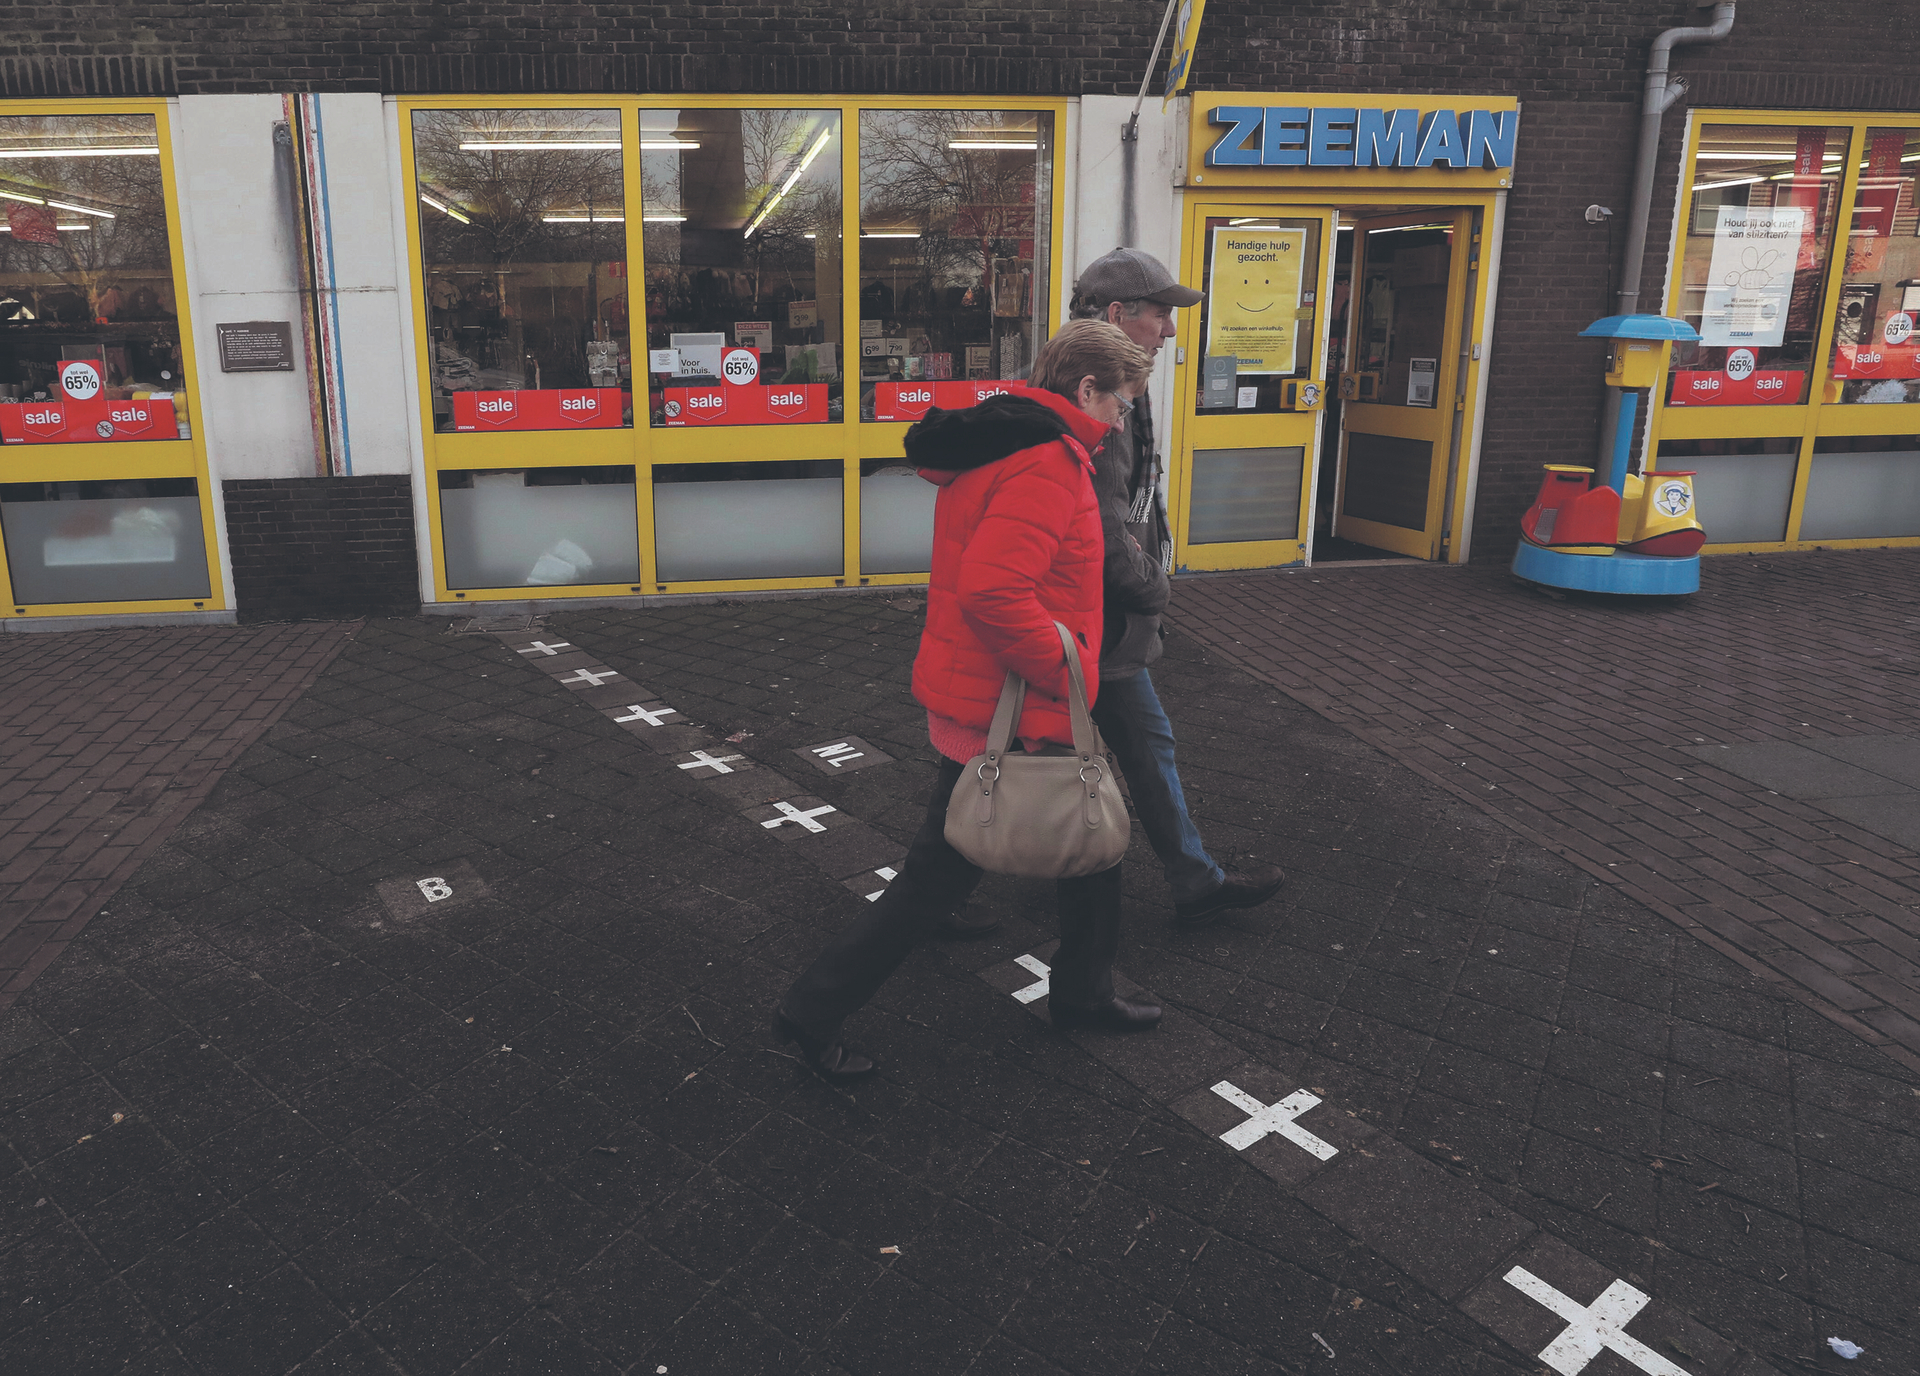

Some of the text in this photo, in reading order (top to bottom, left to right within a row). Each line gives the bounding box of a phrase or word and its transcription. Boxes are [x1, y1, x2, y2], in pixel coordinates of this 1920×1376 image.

[1204, 106, 1517, 168] ZEEMAN
[1724, 218, 1747, 228] Houd
[1760, 218, 1776, 228] ook
[1779, 219, 1796, 228] niet
[1227, 240, 1290, 252] Handige hulp
[1237, 252, 1279, 264] gezocht.
[1886, 323, 1910, 336] 65%
[681, 359, 700, 367] Voor
[1856, 351, 1881, 363] sale
[725, 361, 755, 376] 65%
[1728, 359, 1752, 371] 65%
[65, 375, 98, 390] 65%
[1692, 377, 1720, 390] sale
[1756, 376, 1783, 389] sale
[562, 395, 597, 410] sale
[689, 393, 723, 408] sale
[770, 391, 804, 406] sale
[898, 388, 931, 403] sale
[478, 397, 514, 412] sale
[25, 410, 61, 425] sale
[111, 407, 147, 422] sale
[812, 742, 865, 768] NL
[415, 877, 453, 902] B
